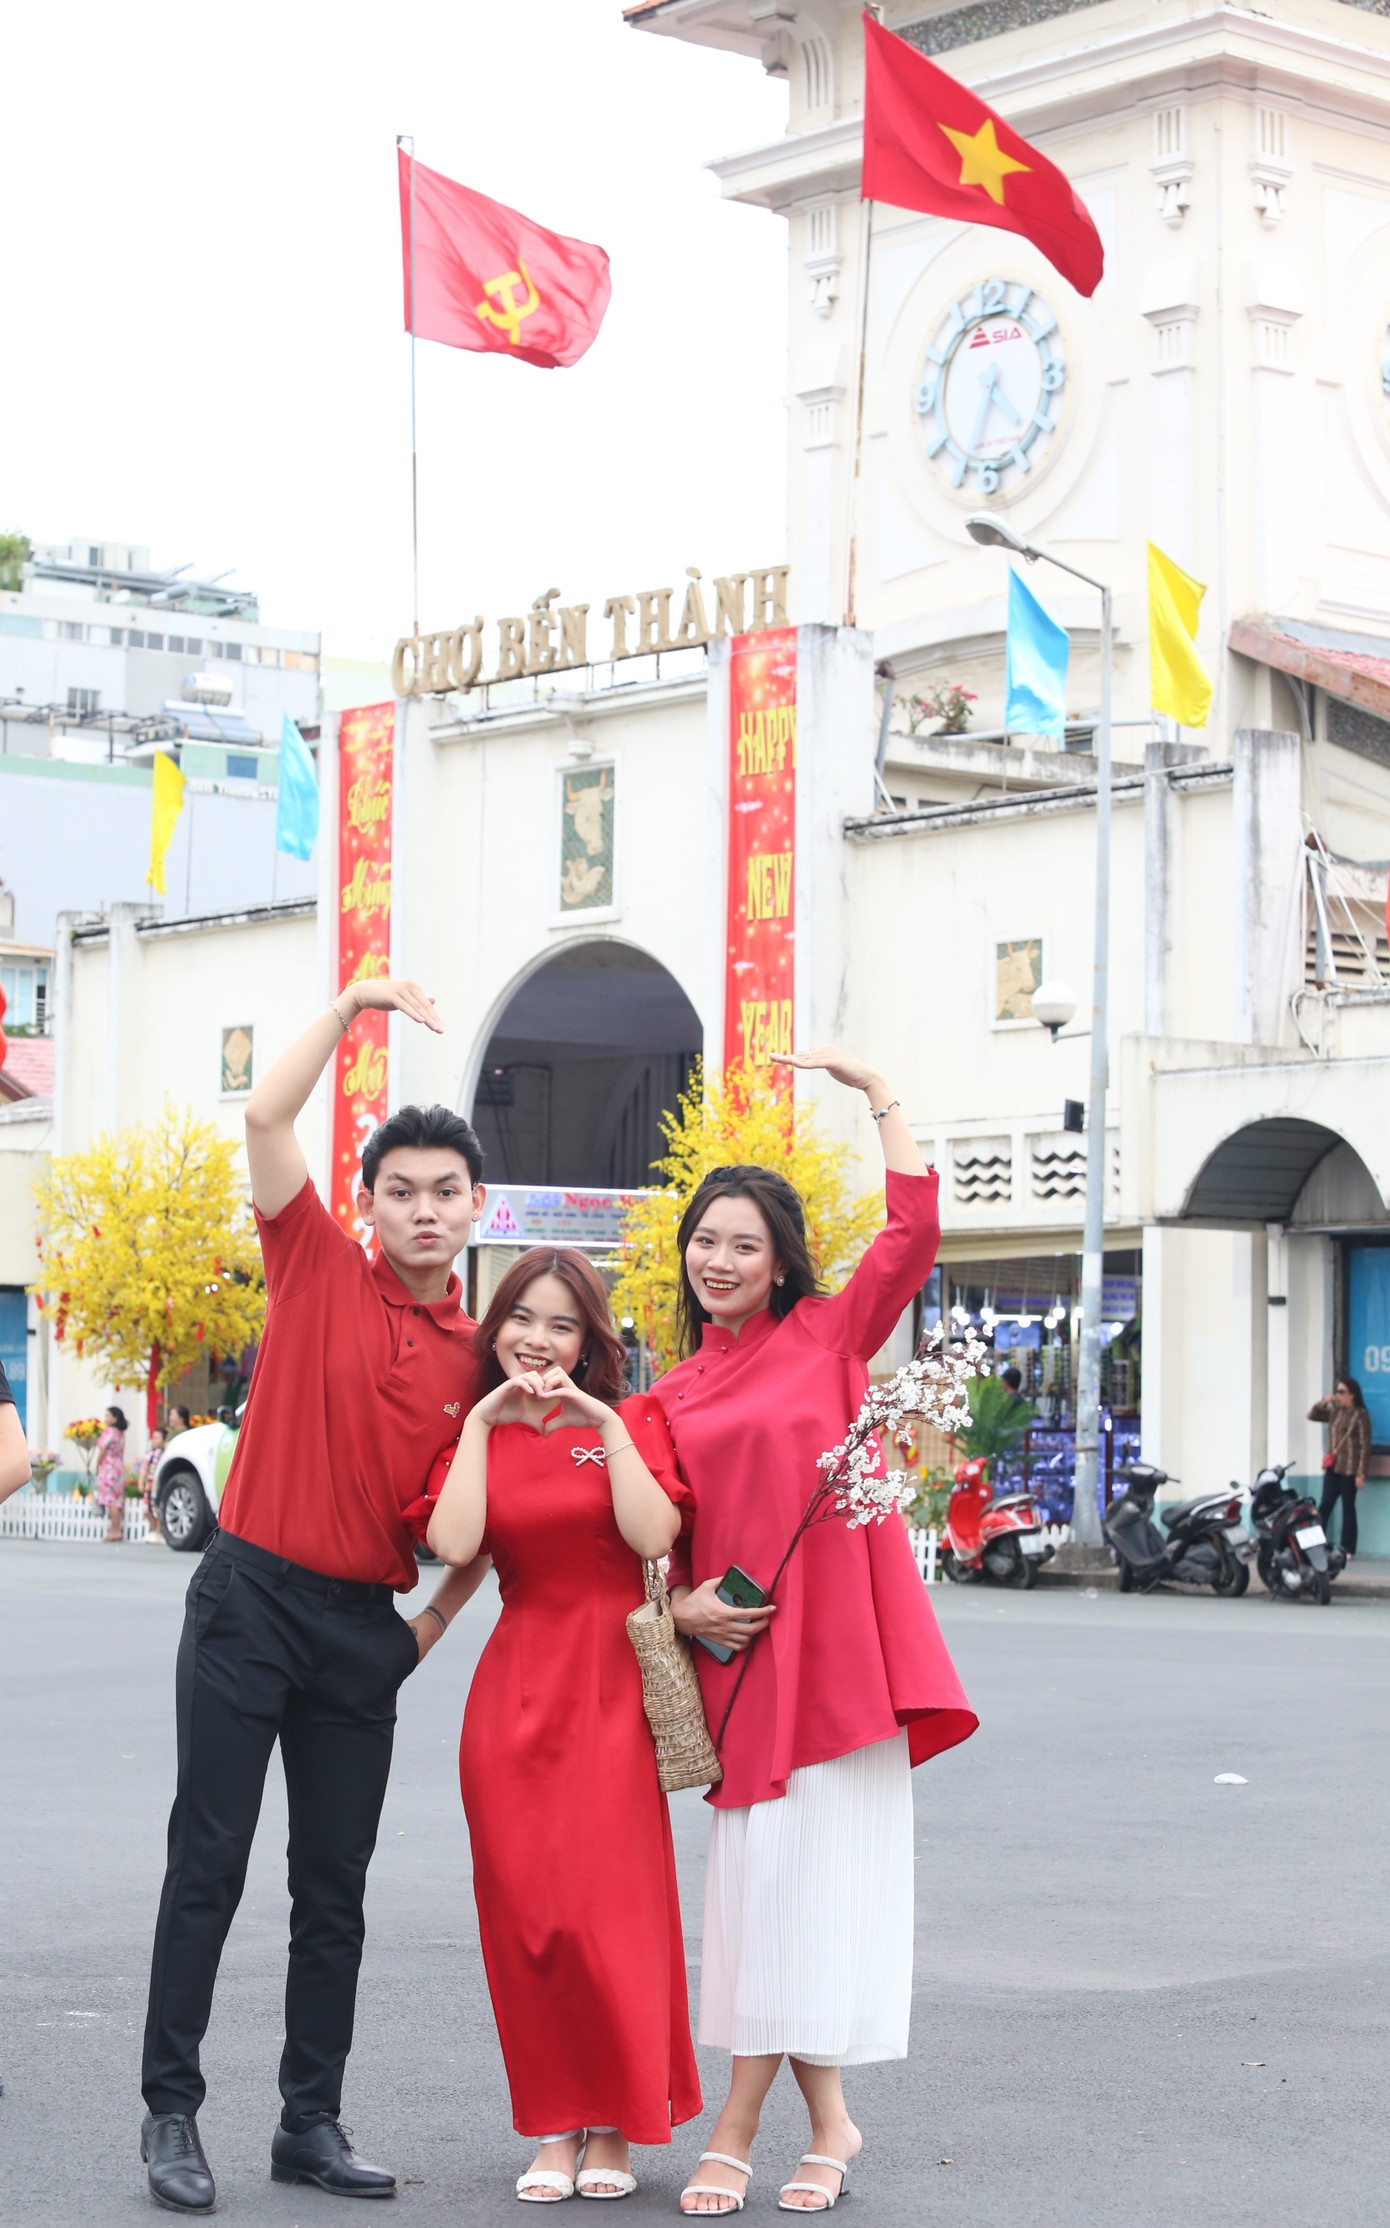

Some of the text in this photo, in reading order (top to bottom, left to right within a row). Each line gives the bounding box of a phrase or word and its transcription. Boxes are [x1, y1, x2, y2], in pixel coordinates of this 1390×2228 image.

[972, 279, 1006, 317] 12
[914, 382, 935, 414] 9
[1041, 357, 1066, 391] 3
[977, 460, 999, 494] 6
[392, 565, 791, 696] CHỢ BẾN THÀNH
[736, 704, 796, 777] HAPPY
[747, 851, 793, 921] NEW
[740, 999, 793, 1072] YEAR
